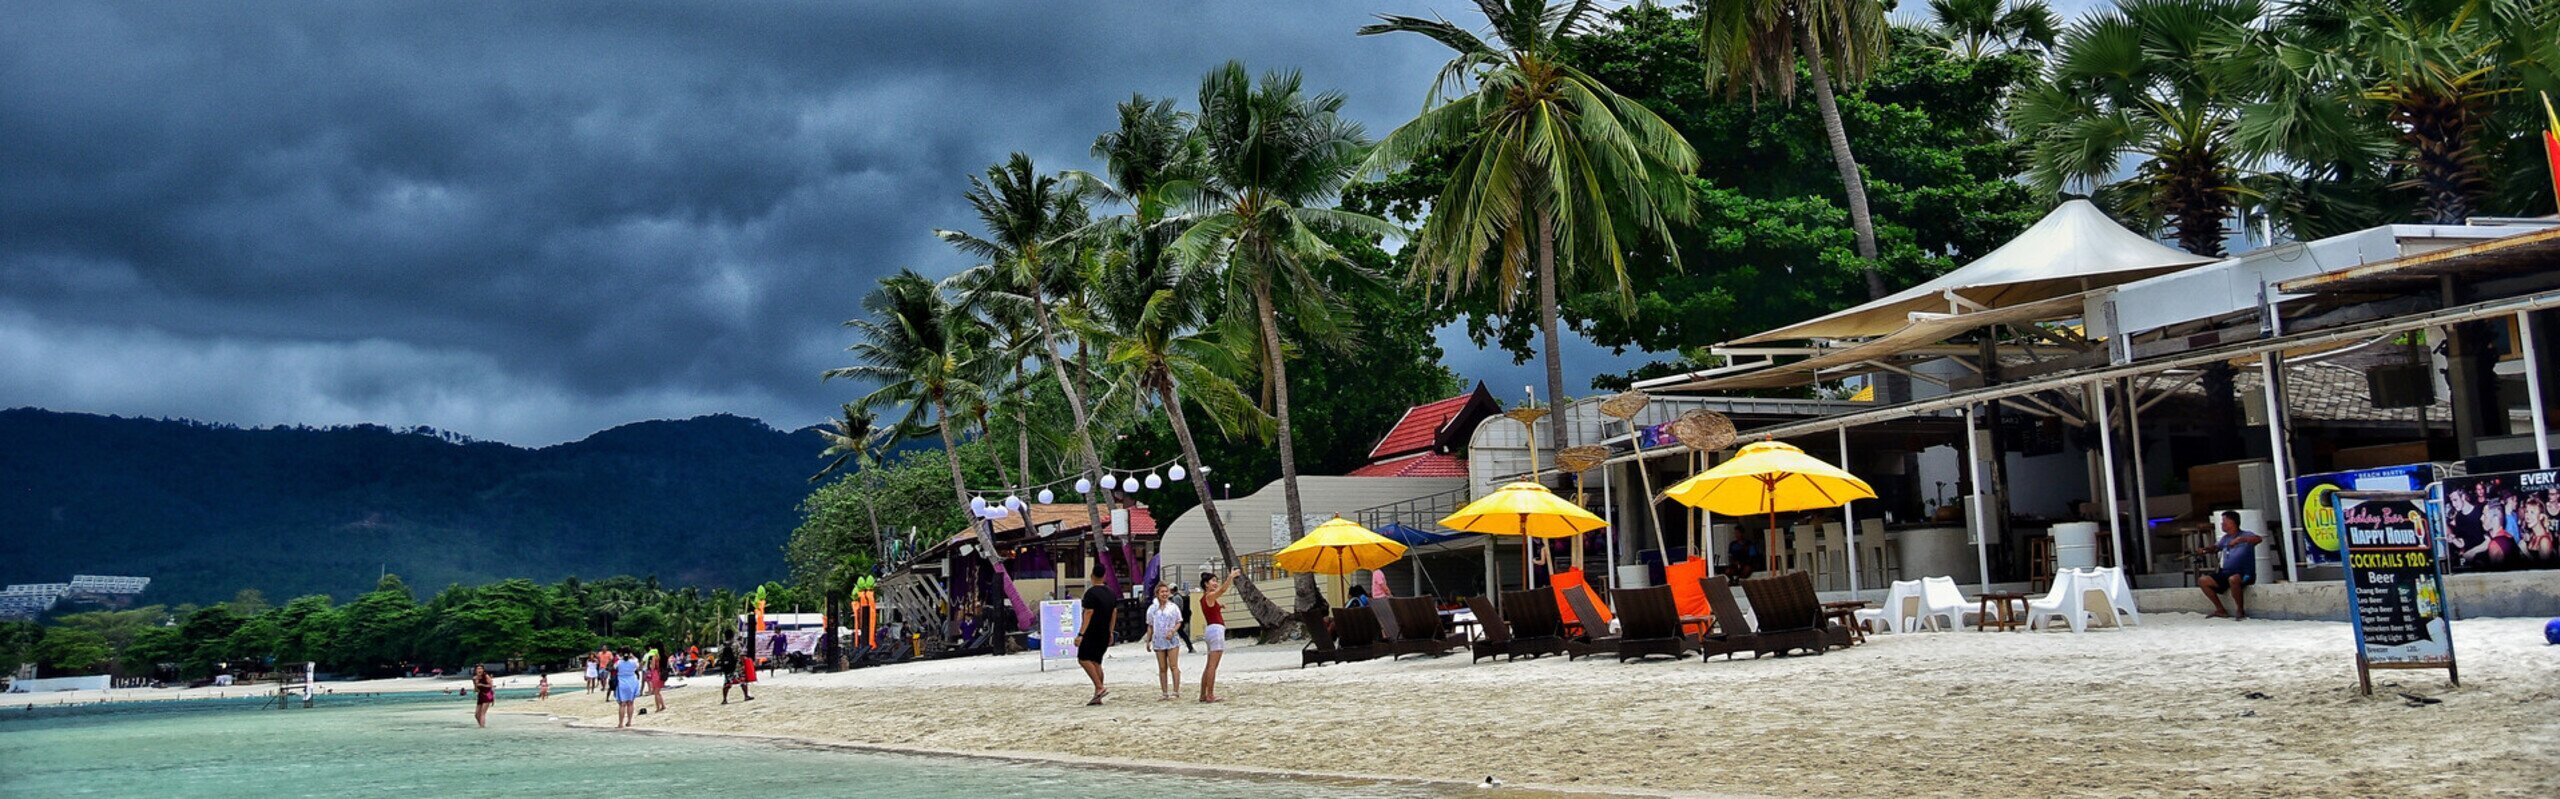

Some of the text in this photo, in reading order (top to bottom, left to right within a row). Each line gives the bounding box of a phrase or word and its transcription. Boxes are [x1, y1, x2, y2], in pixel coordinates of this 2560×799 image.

[2520, 471, 2557, 486] EVERY
[2350, 527, 2417, 544] HAPPY HOUR
[2349, 553, 2403, 568] COCKTAILS
[2368, 571, 2395, 583] Beer
[2360, 606, 2378, 614] Singha
